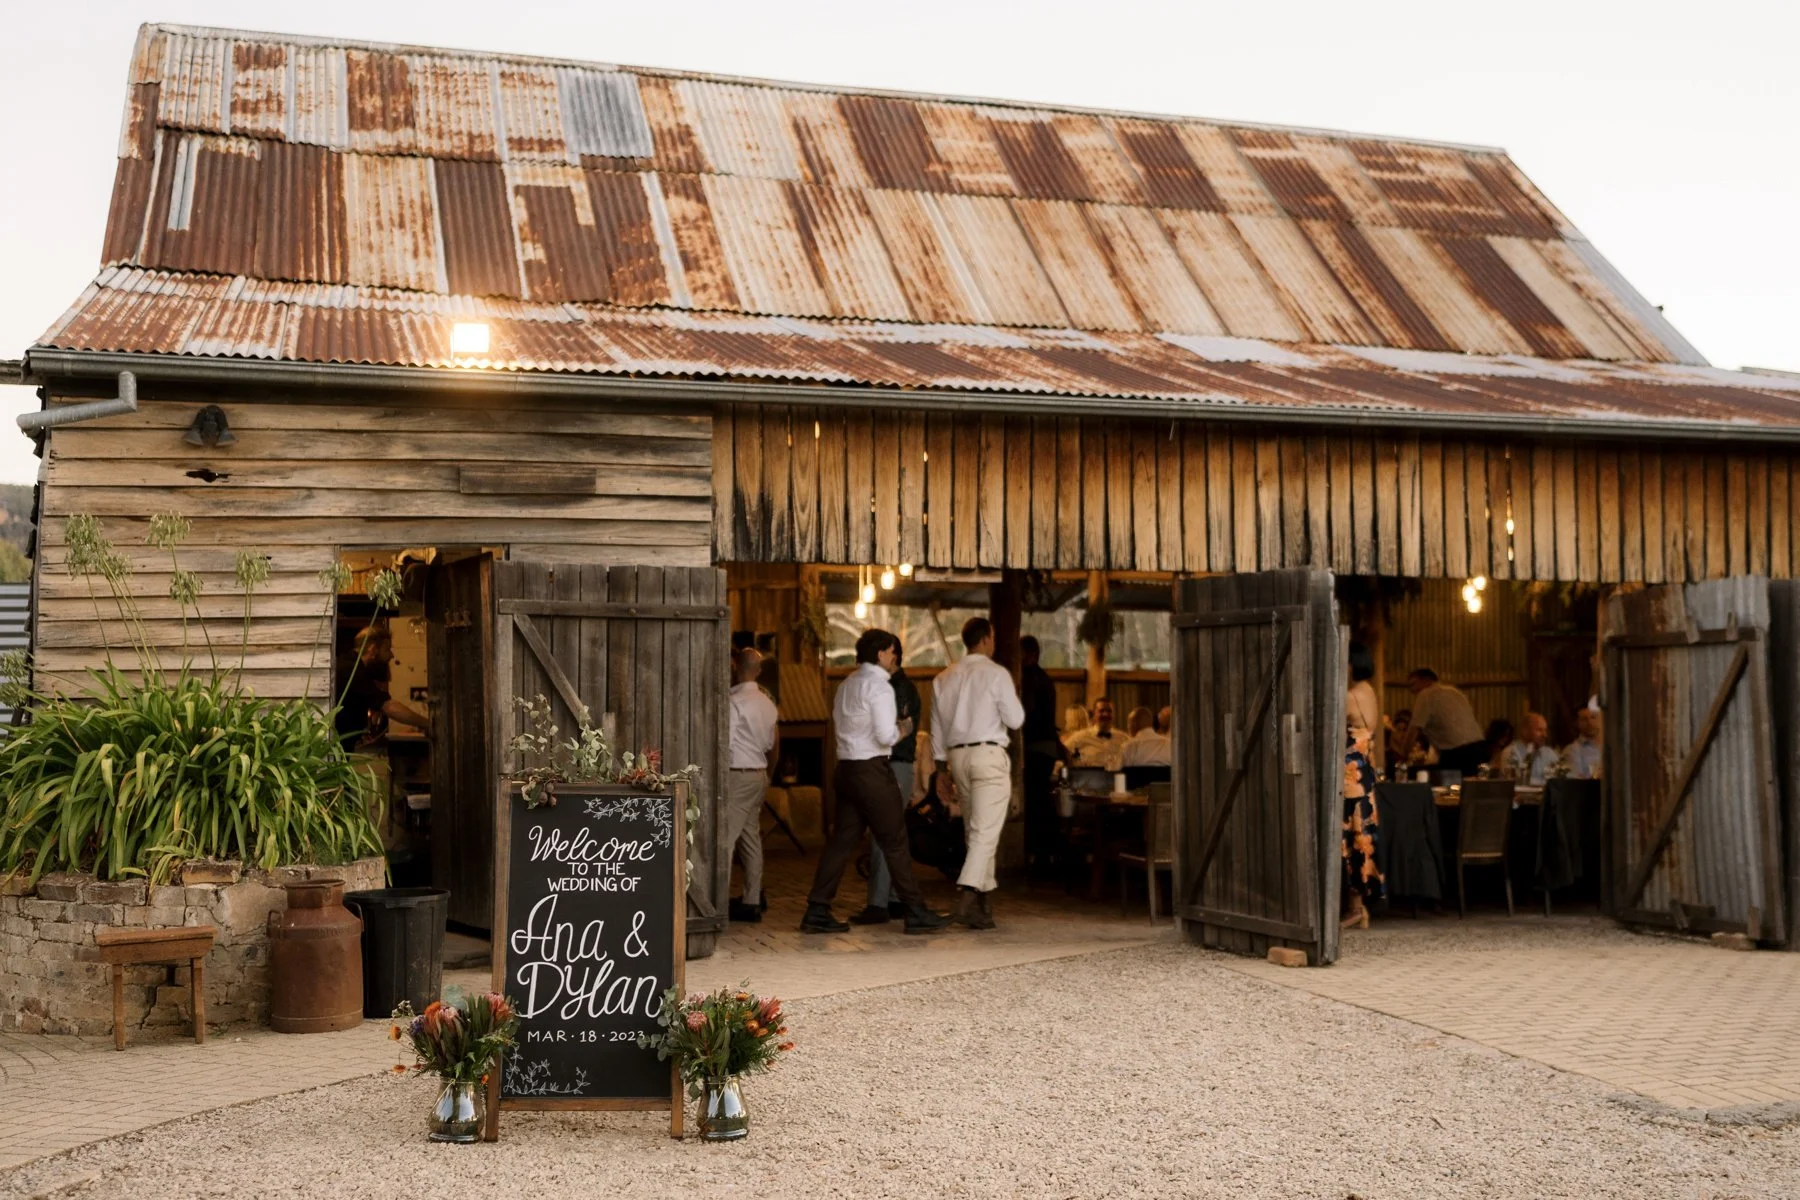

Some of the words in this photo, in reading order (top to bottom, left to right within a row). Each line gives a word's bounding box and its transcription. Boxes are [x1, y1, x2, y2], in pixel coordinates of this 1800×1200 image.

[528, 825, 656, 862] Welcome
[547, 877, 618, 892] WEDDING
[620, 877, 642, 892] OF
[567, 862, 589, 876] TO
[593, 862, 626, 876] THE
[511, 893, 608, 963] Ana
[623, 910, 650, 958] &
[516, 959, 664, 1021] Dylan
